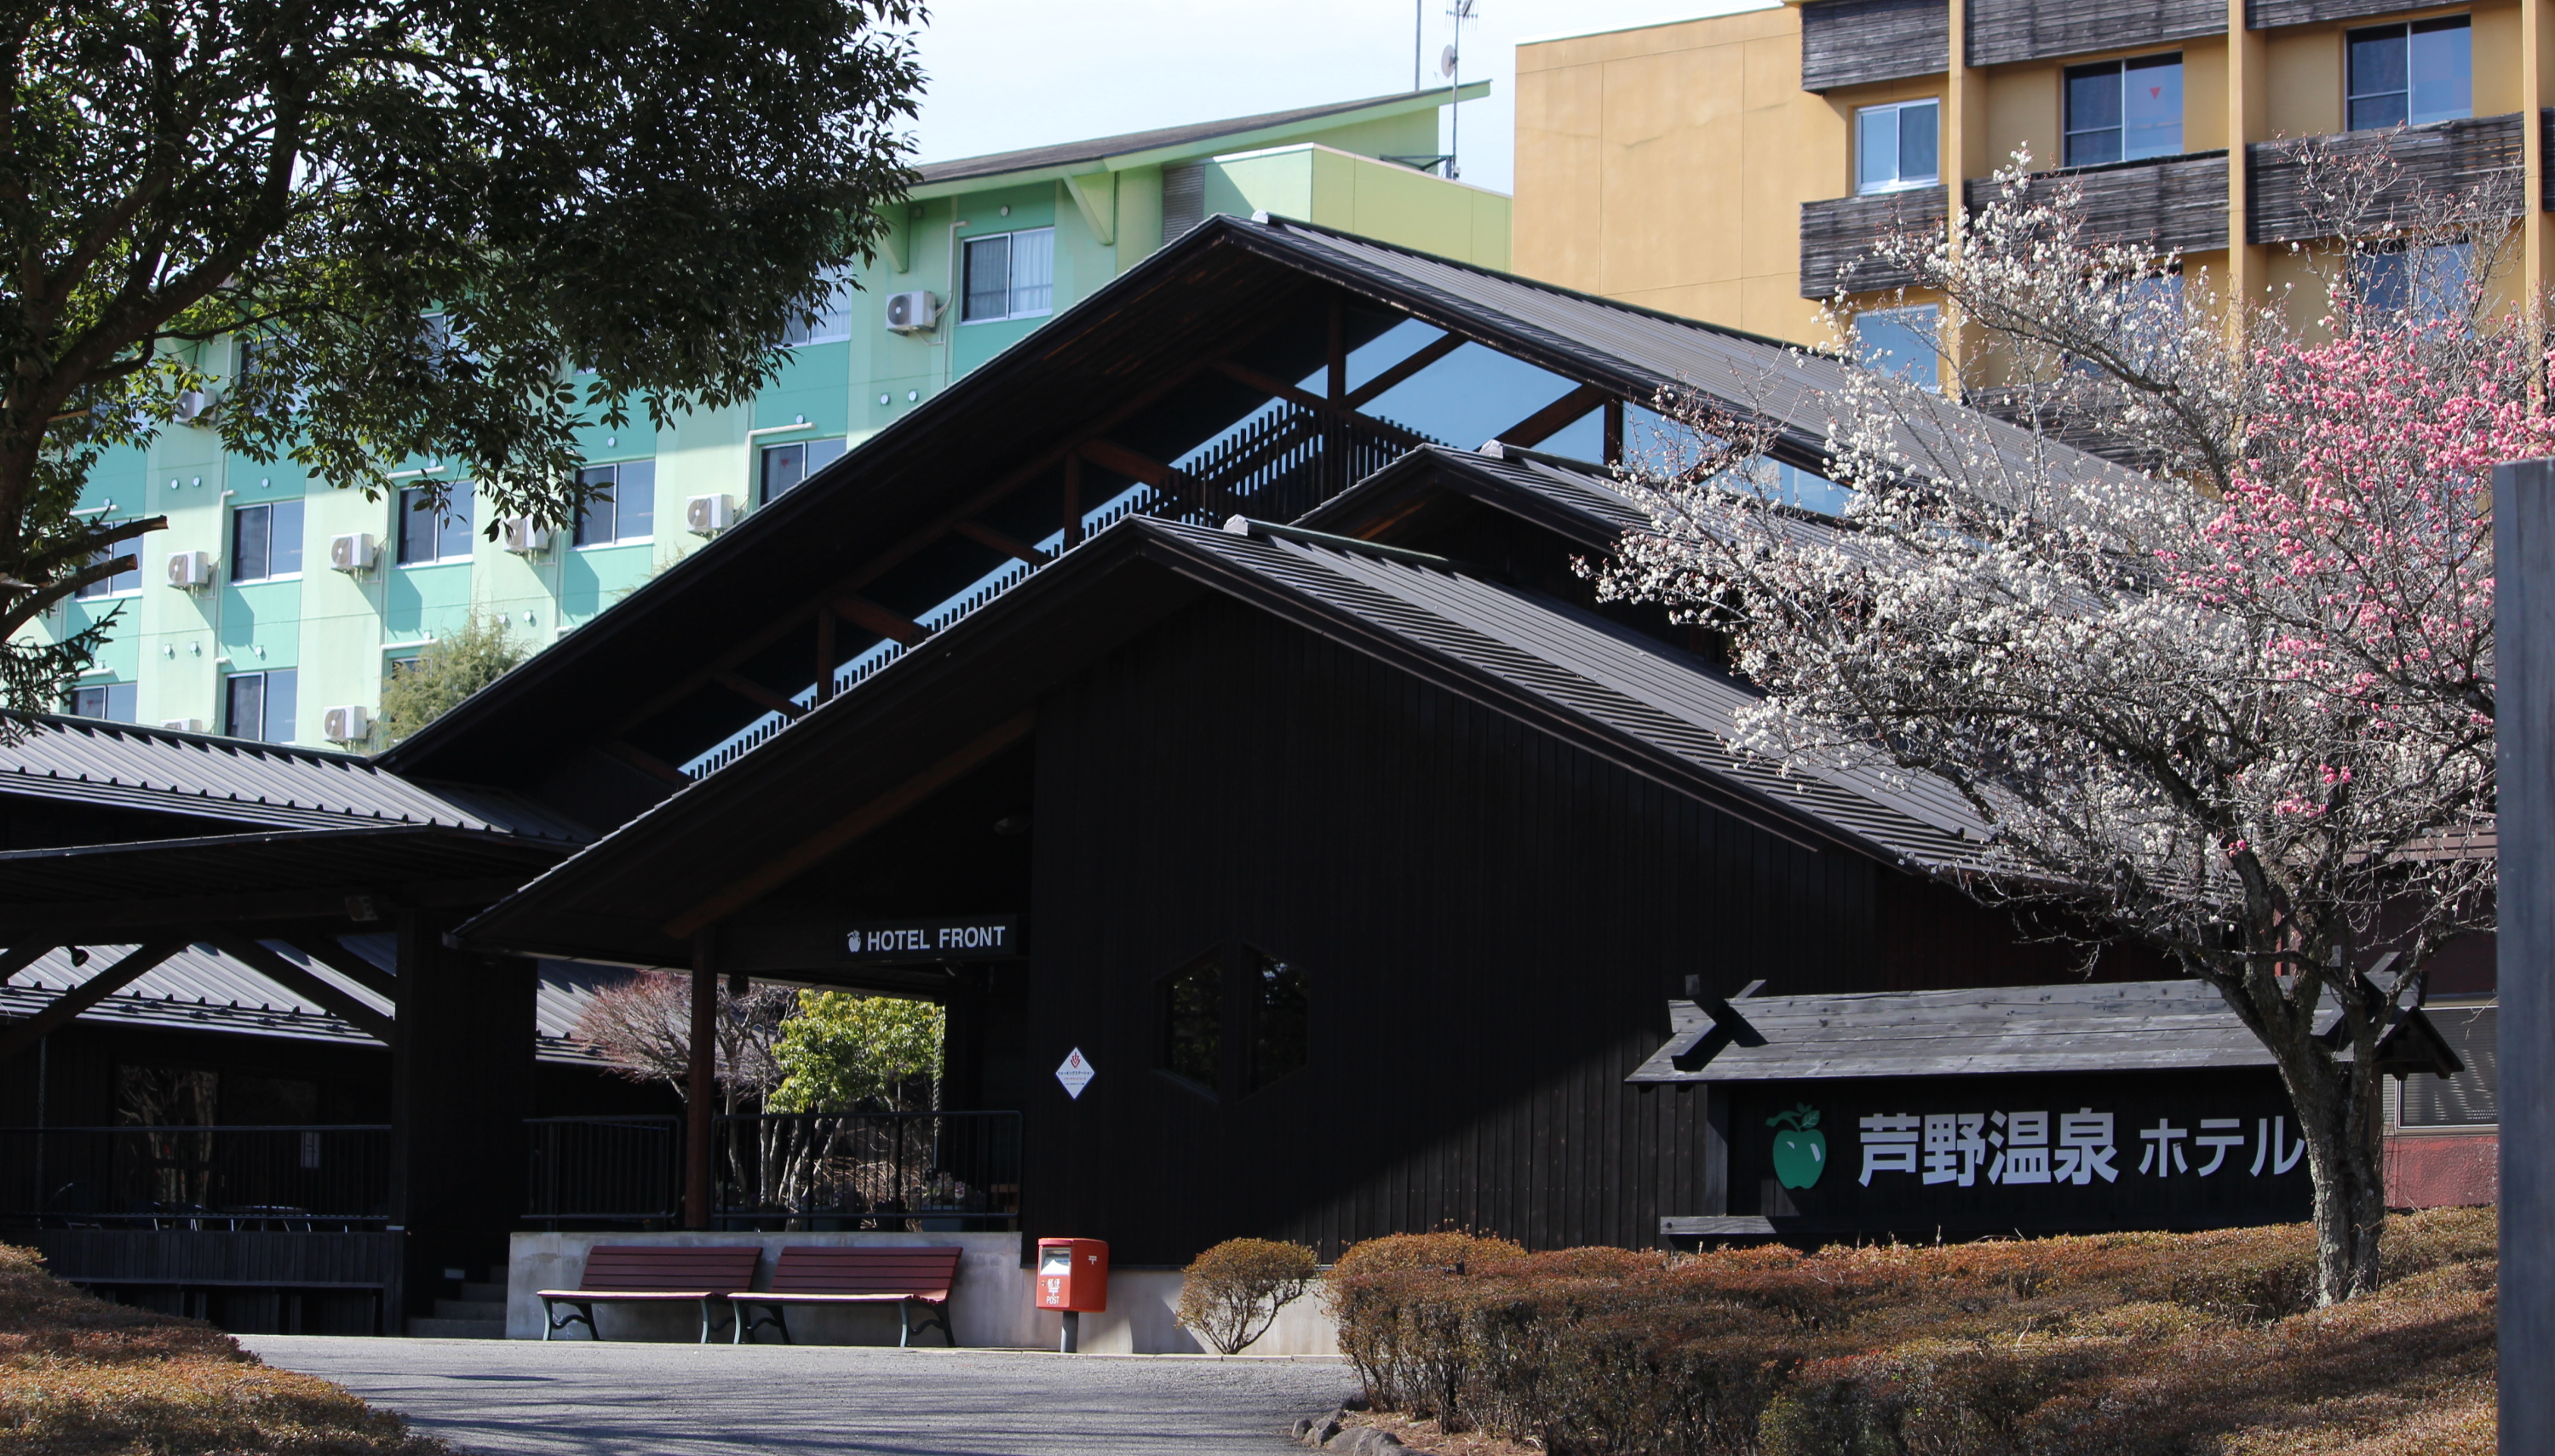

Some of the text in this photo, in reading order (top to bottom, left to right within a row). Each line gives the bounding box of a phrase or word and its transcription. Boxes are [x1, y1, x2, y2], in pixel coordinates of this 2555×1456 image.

[868, 926, 1005, 951] HOTEL FRONT
[1859, 1109, 2305, 1186] 芦野温泉 ホテル
[1046, 1296, 1059, 1304] POST
